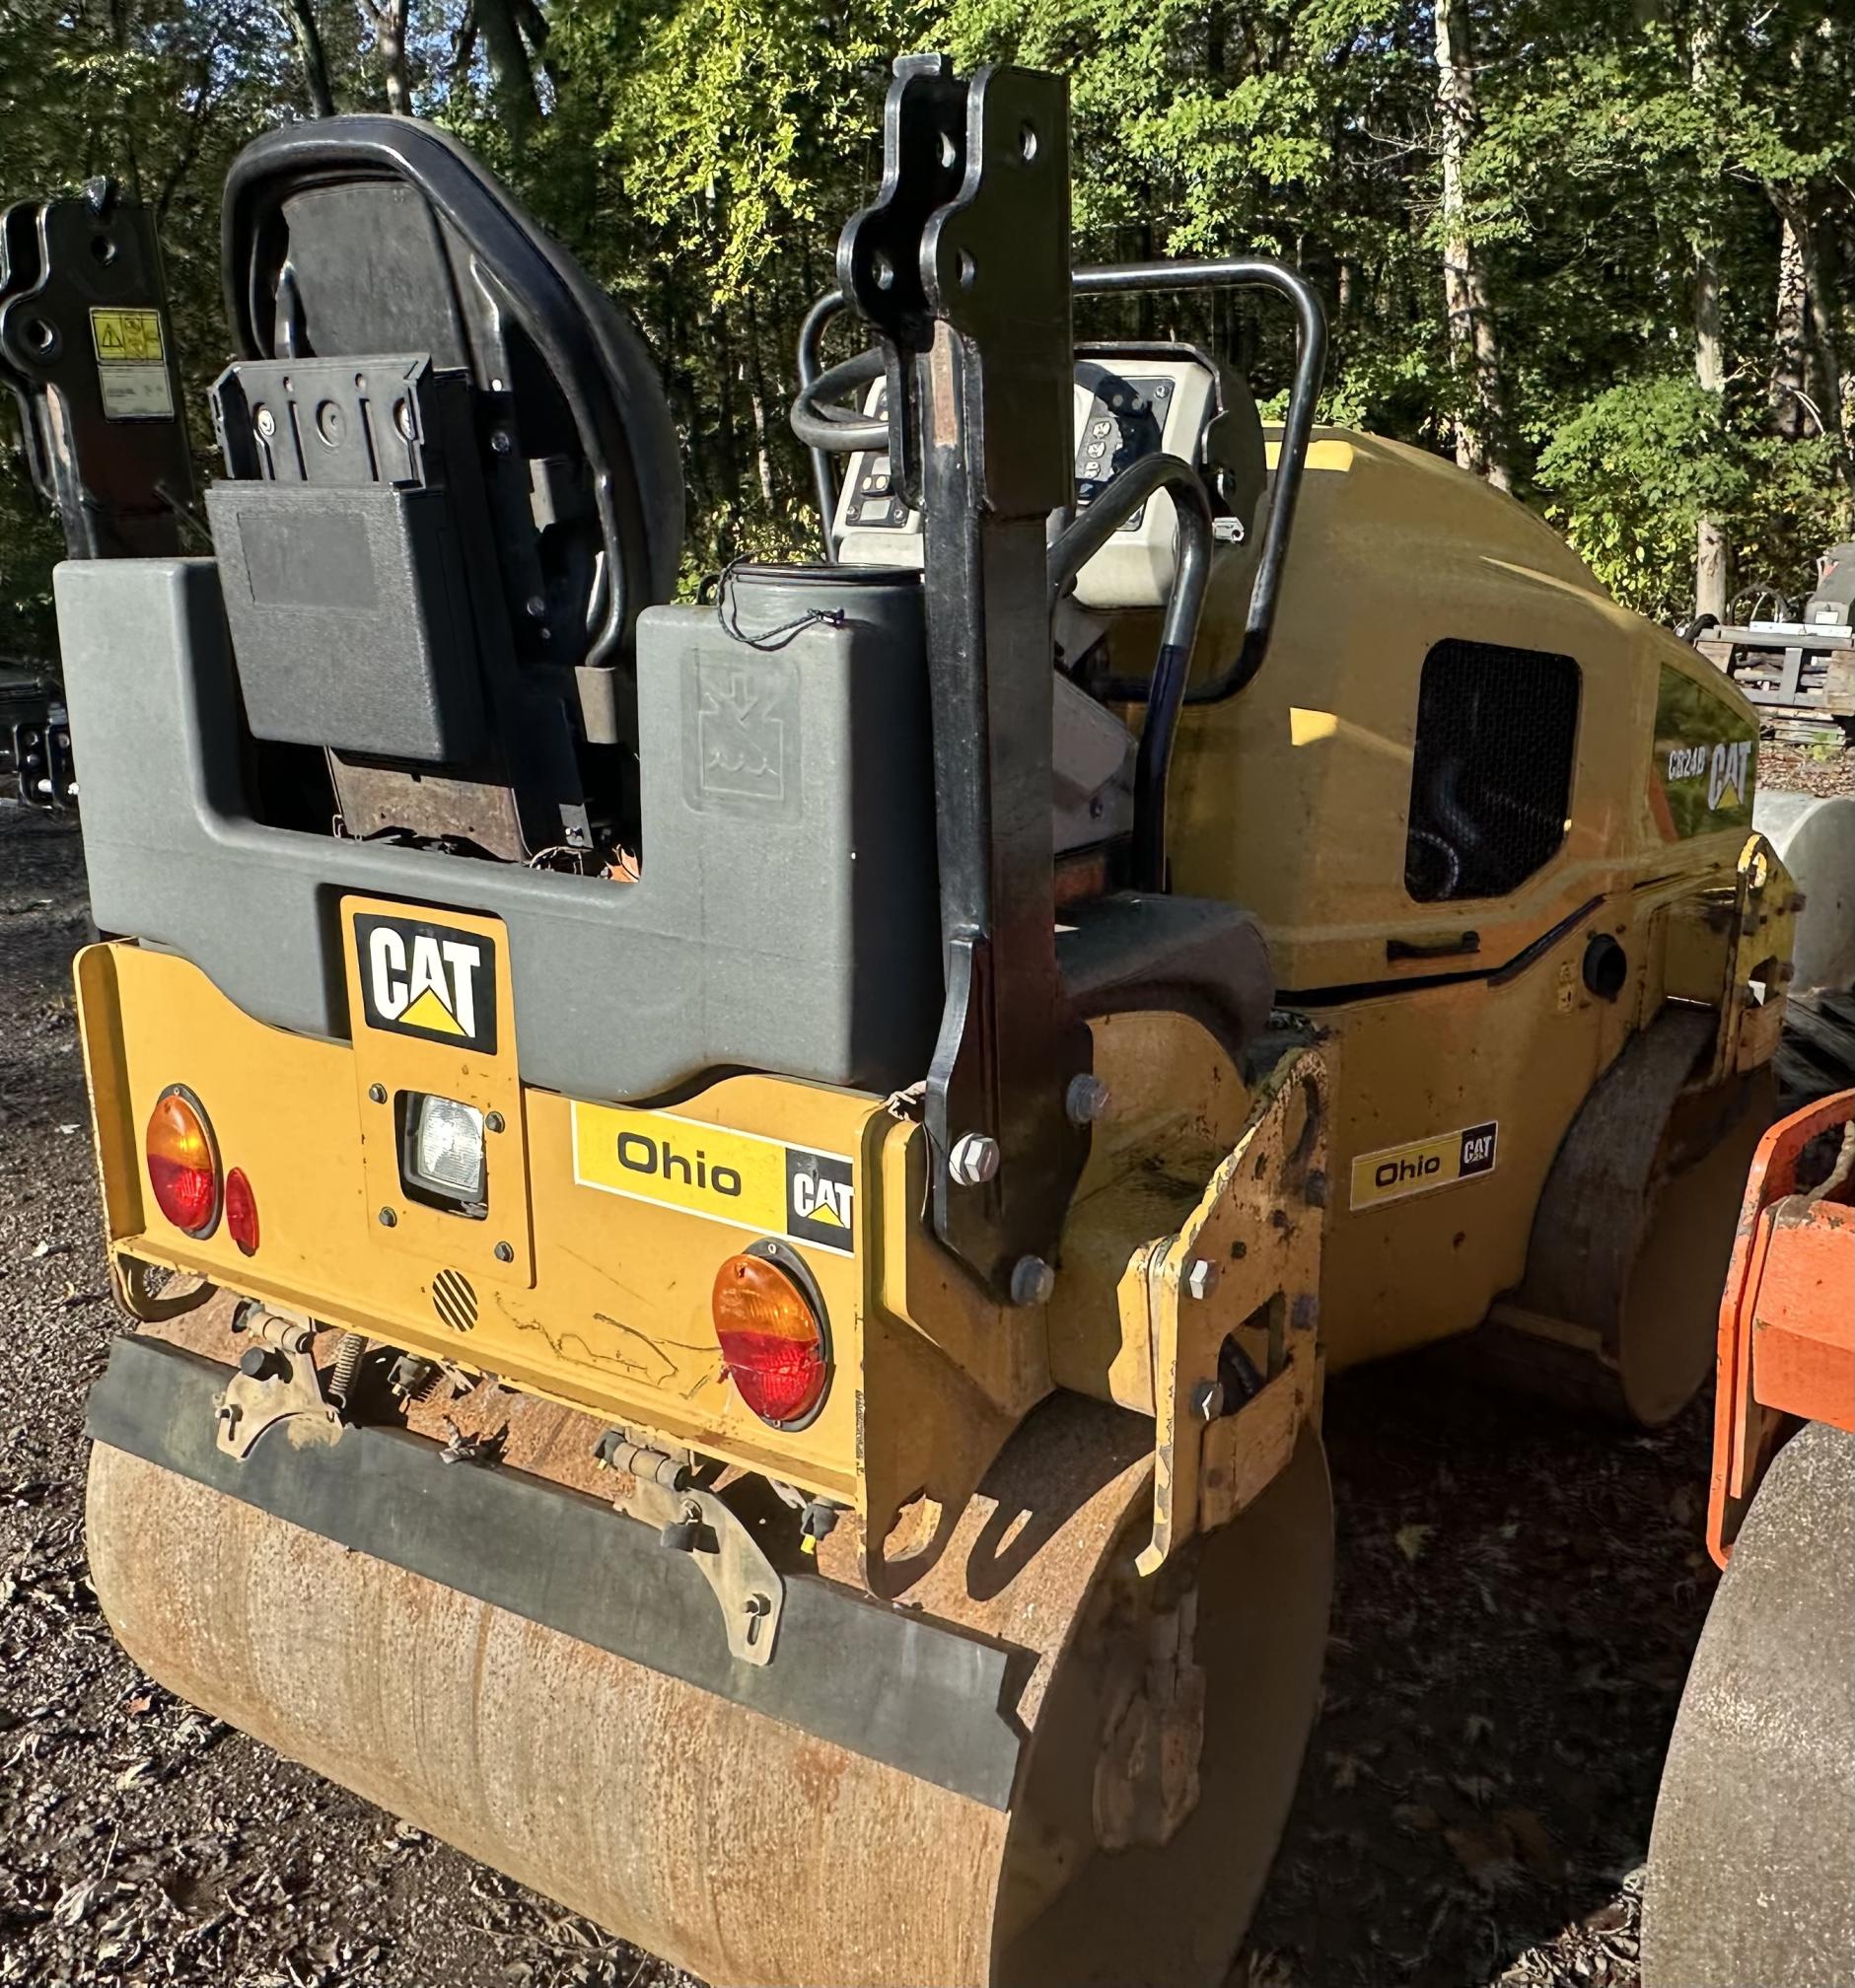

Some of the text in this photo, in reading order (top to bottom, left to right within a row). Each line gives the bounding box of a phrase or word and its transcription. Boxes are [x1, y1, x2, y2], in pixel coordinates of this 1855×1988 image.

[1708, 742, 1751, 811] CAT
[369, 927, 481, 1038] CAT
[617, 1131, 855, 1230] Ohio CAT
[1375, 1135, 1493, 1188] Ohio CAT
